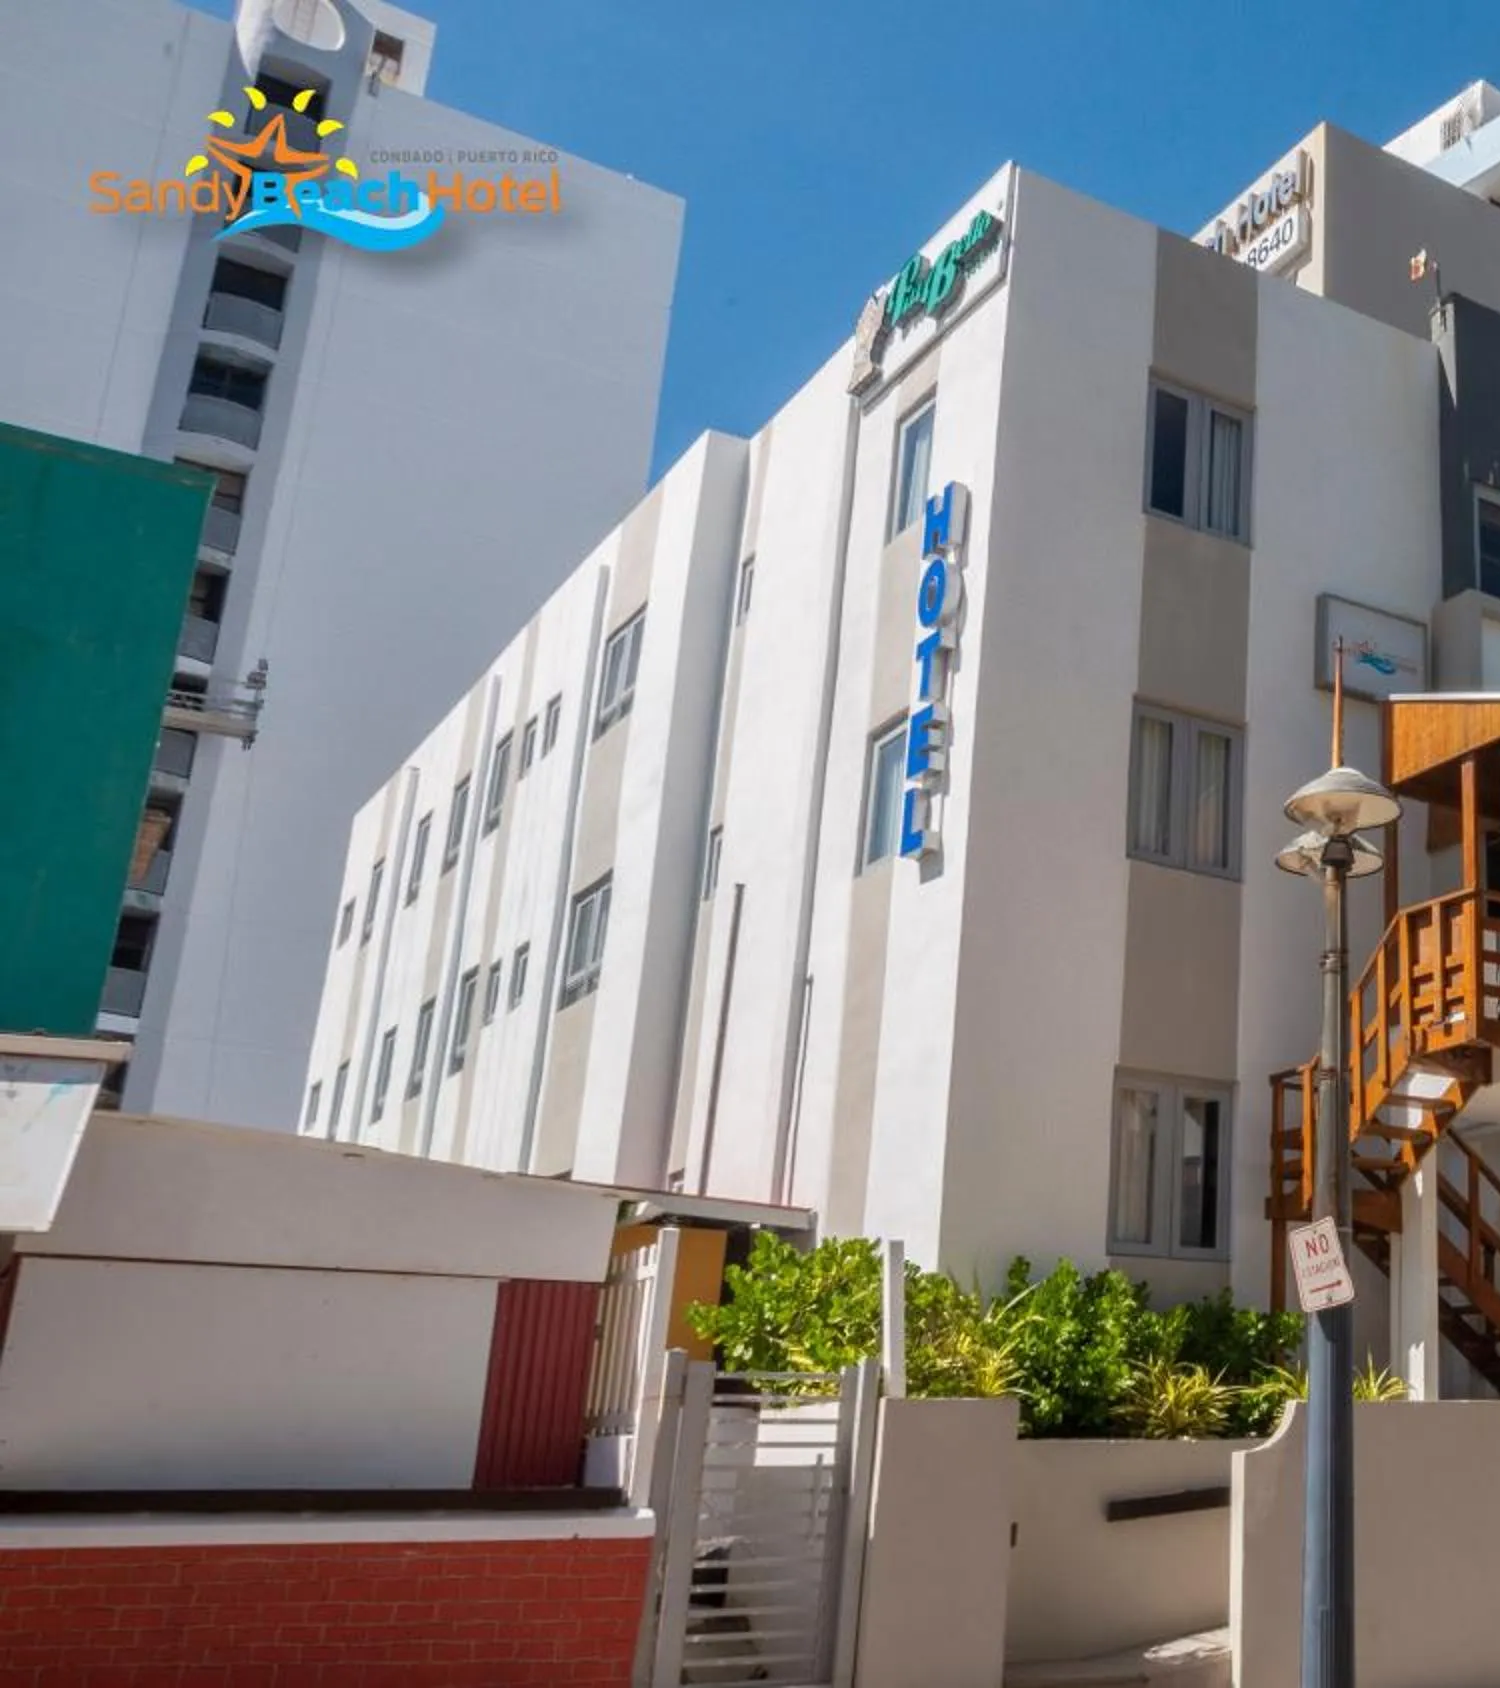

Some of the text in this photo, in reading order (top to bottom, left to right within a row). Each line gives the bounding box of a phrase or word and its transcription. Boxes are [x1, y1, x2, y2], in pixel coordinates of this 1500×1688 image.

[1237, 149, 1304, 243] Hotel
[900, 481, 960, 857] HOTEL
[1304, 1234, 1329, 1257] NO
